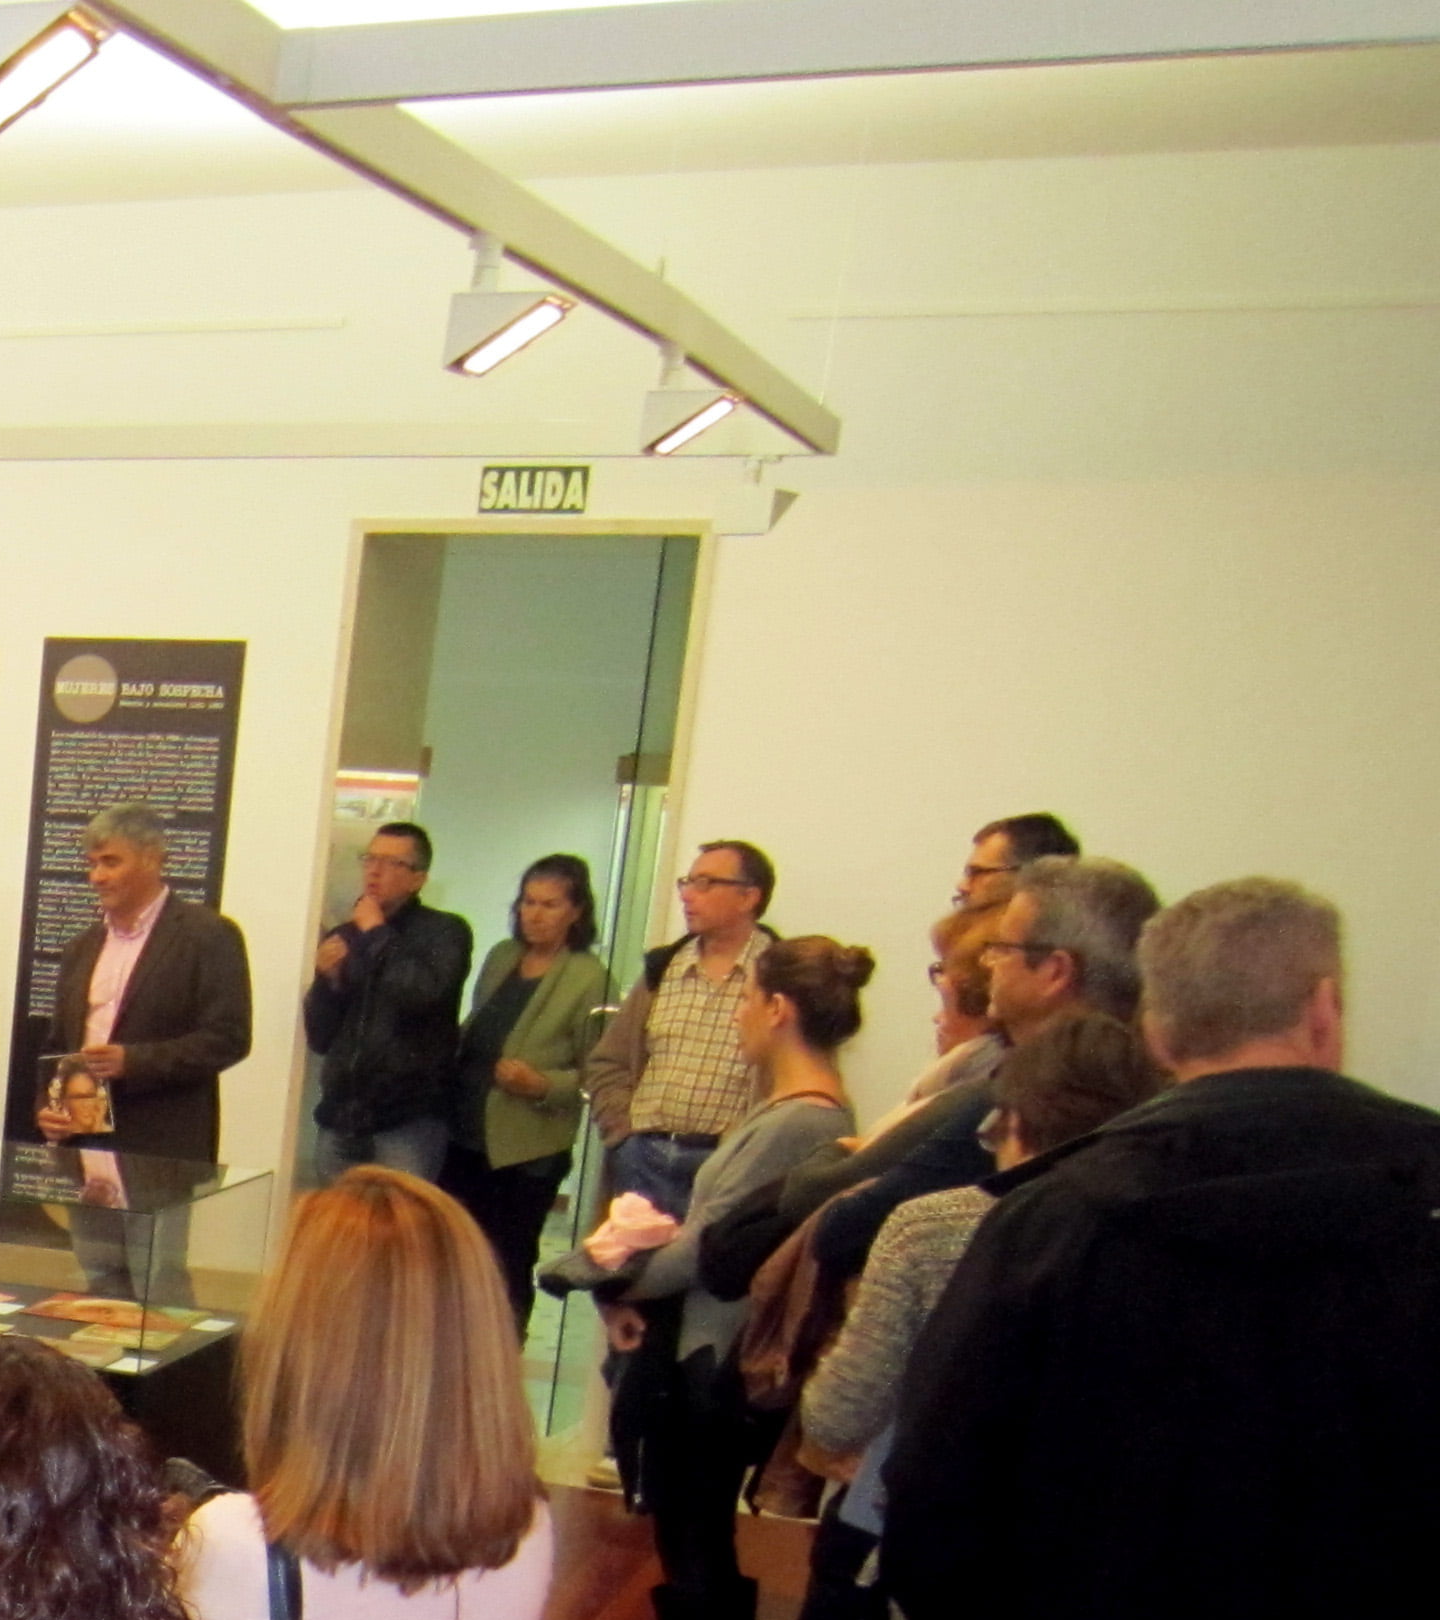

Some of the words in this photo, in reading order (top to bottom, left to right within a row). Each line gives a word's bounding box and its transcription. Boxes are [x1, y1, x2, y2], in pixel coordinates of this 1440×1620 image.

[480, 469, 586, 510] SALIDA
[121, 682, 154, 697] BAJO
[159, 683, 224, 699] SOSPECHA
